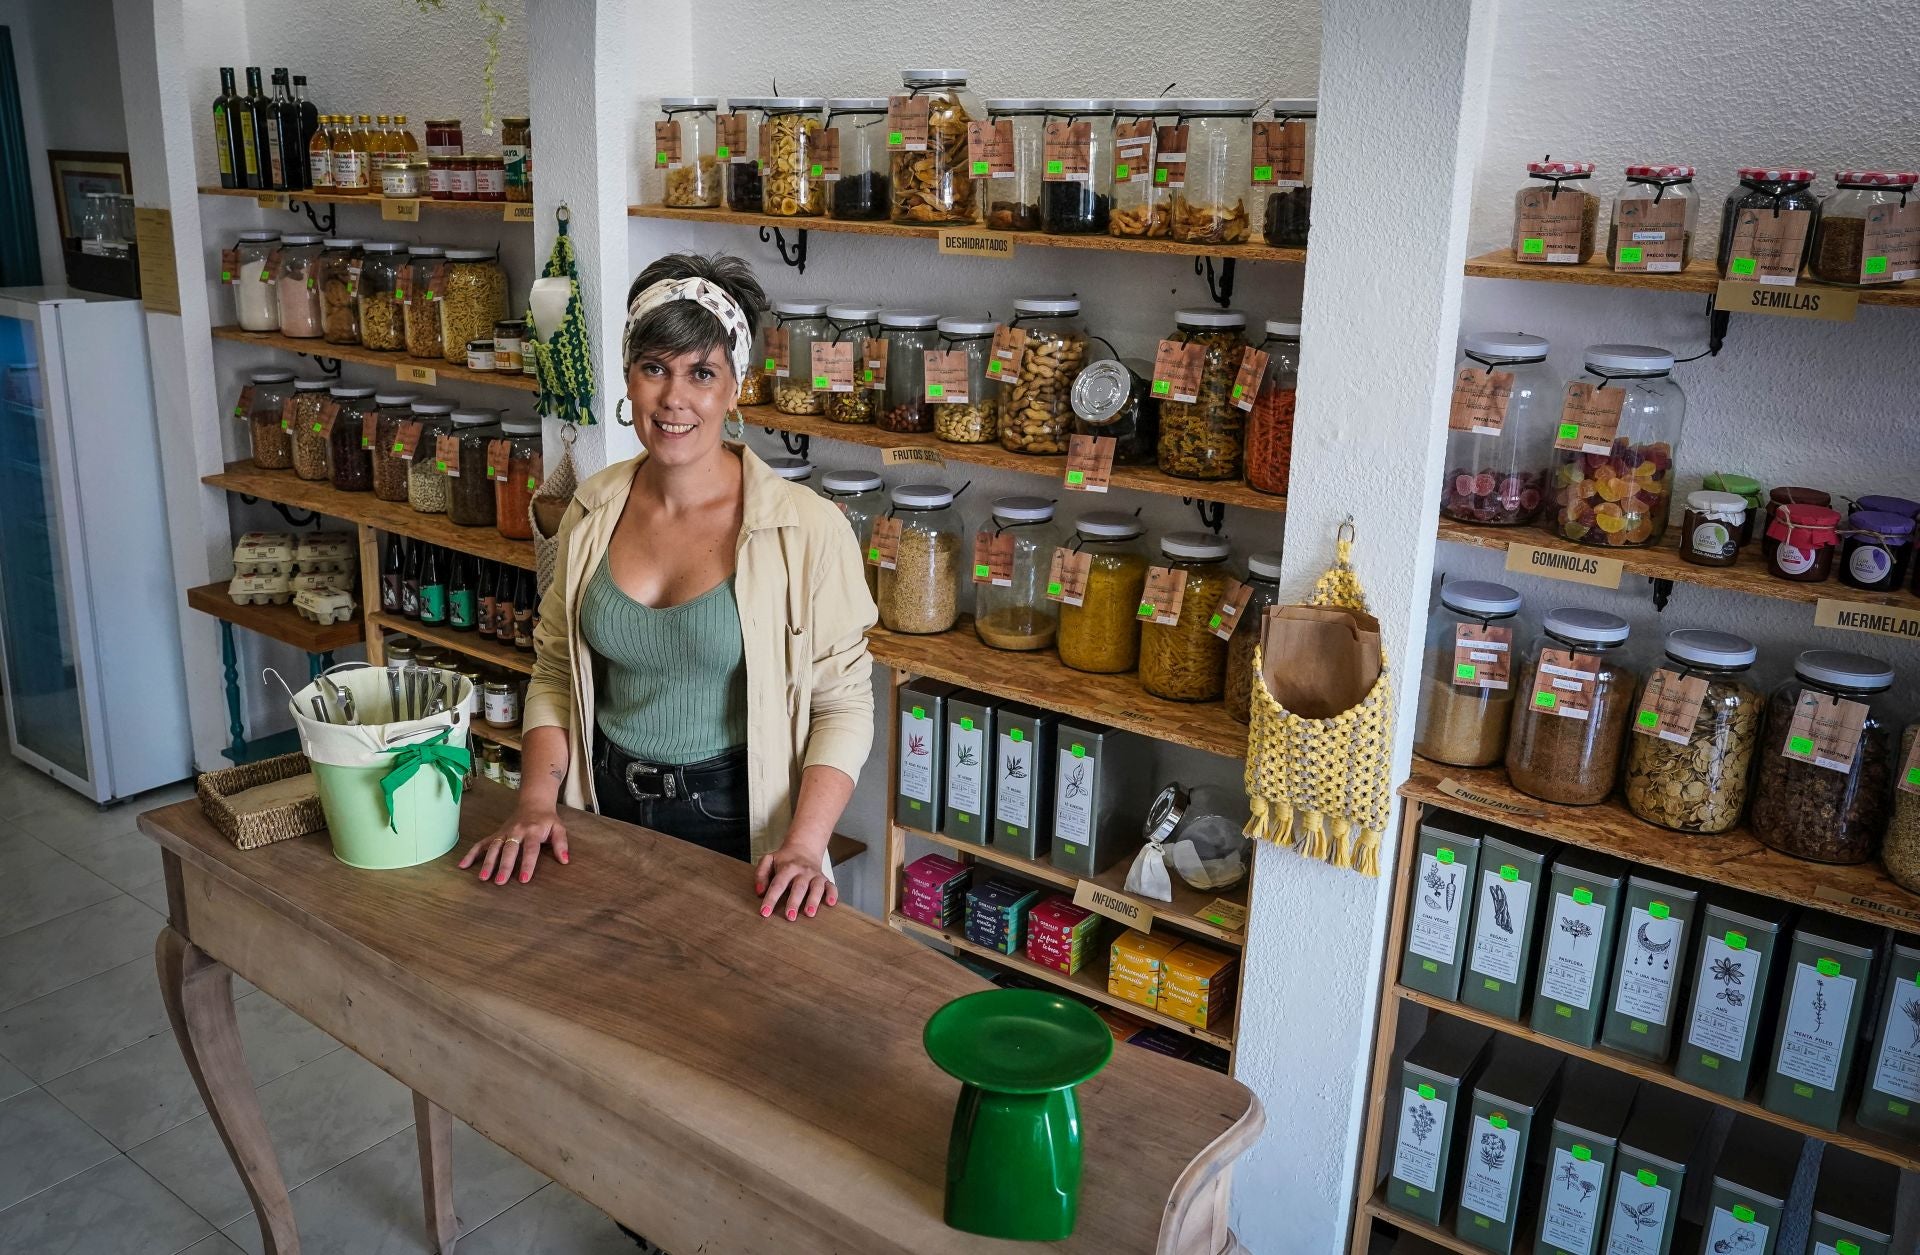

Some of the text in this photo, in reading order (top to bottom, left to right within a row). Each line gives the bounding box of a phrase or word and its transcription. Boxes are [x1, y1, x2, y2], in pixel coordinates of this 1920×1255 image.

[946, 236, 1008, 252] DESHIDRATADOS
[1751, 289, 1821, 311] SEMILLAS
[892, 449, 924, 461] FRUTOS
[1531, 550, 1599, 574] GOMINOLAS
[1120, 710, 1156, 722] PASTAS
[1817, 747, 1836, 755] PRECIO
[1454, 788, 1530, 813] ENDULZANTES
[1091, 890, 1139, 919] INFUSIONES
[1850, 896, 1920, 919] CEREALES
[1433, 915, 1450, 925] VEGGIE
[1489, 933, 1508, 942] REGALIZ
[1558, 956, 1584, 968] PASIFLORA
[1715, 1006, 1728, 1014] ANÍS
[1793, 1030, 1833, 1047] MENTA POLEO
